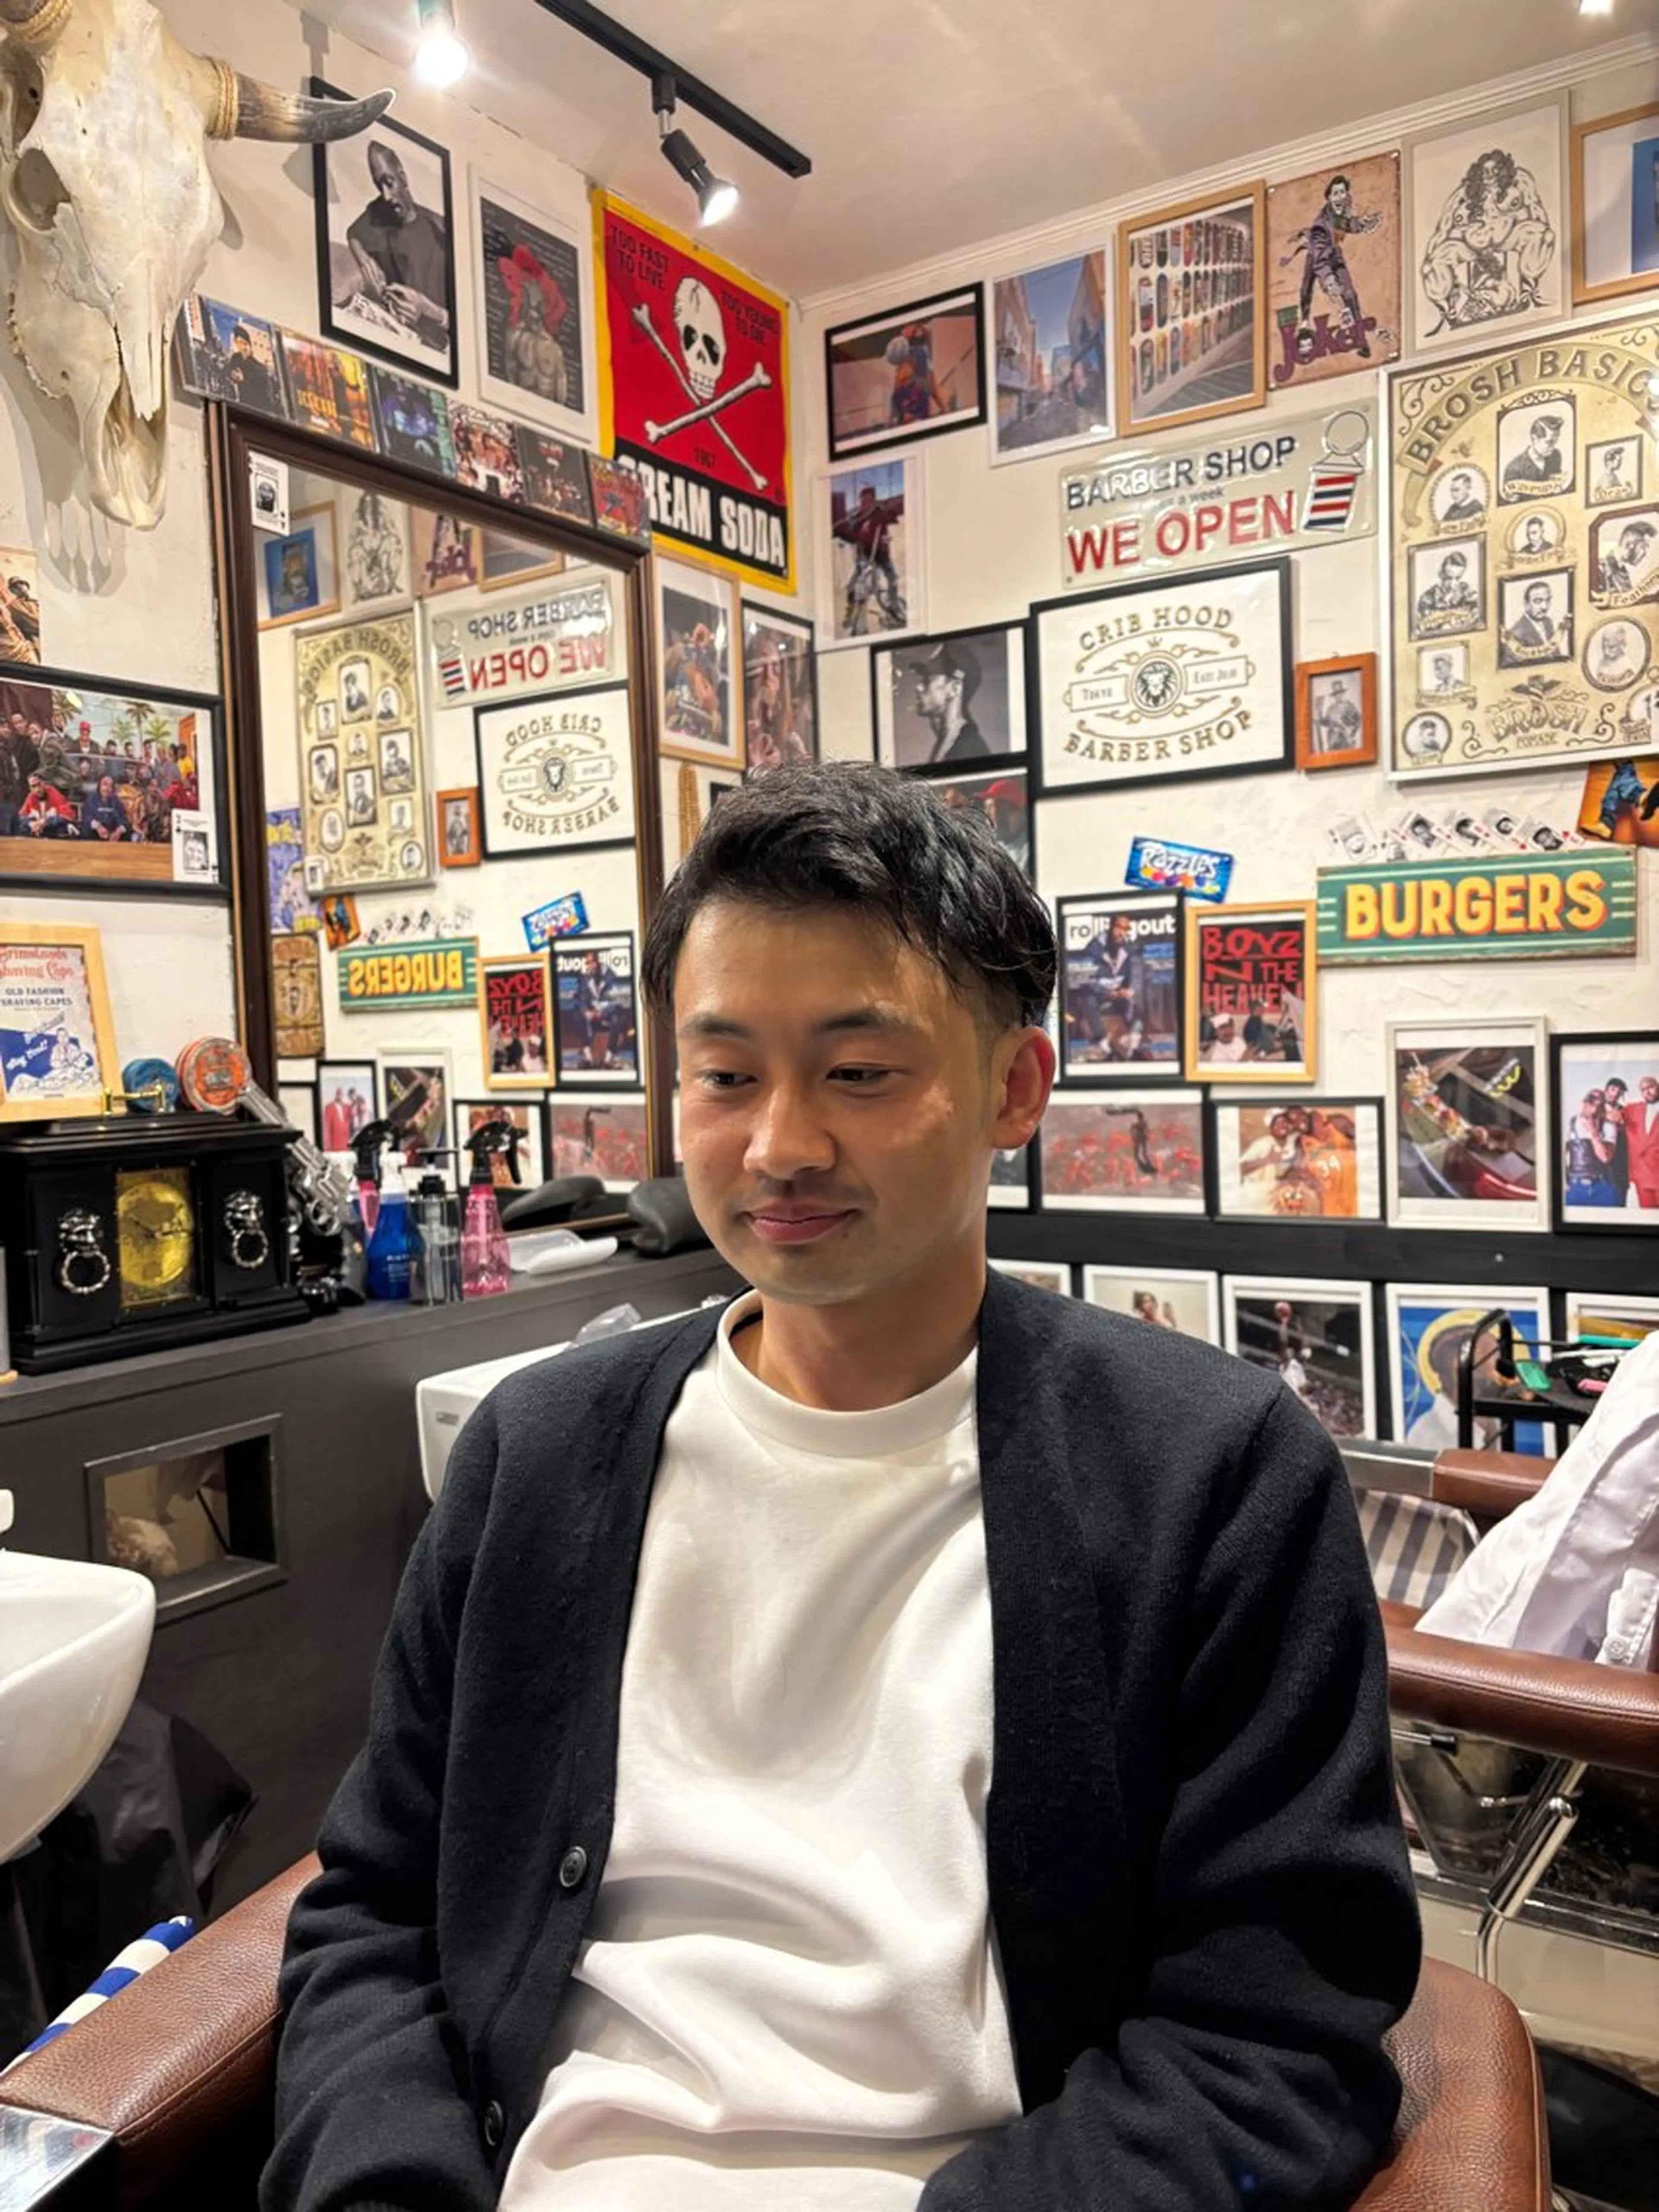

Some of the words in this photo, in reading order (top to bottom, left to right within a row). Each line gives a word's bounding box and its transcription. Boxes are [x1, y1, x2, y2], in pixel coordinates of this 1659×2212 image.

[610, 224, 636, 254] TOO
[639, 242, 669, 273] FAST
[617, 249, 635, 274] TO
[637, 260, 666, 292] LIVE
[1274, 305, 1377, 382] Joker
[1405, 358, 1521, 464] BROSH
[1067, 458, 1195, 510] BARBER
[1206, 435, 1296, 480] SHOP
[719, 495, 785, 568] SODA
[1067, 521, 1140, 574] WE
[1156, 489, 1294, 557] OPEN
[1080, 612, 1142, 651] CRIB
[1153, 605, 1233, 629] HOOD
[1063, 732, 1171, 763] BARBER
[1179, 709, 1252, 755] SHOP
[1345, 870, 1608, 941] BURGERS
[1203, 927, 1302, 960] BOYZ
[1260, 961, 1299, 982] THE
